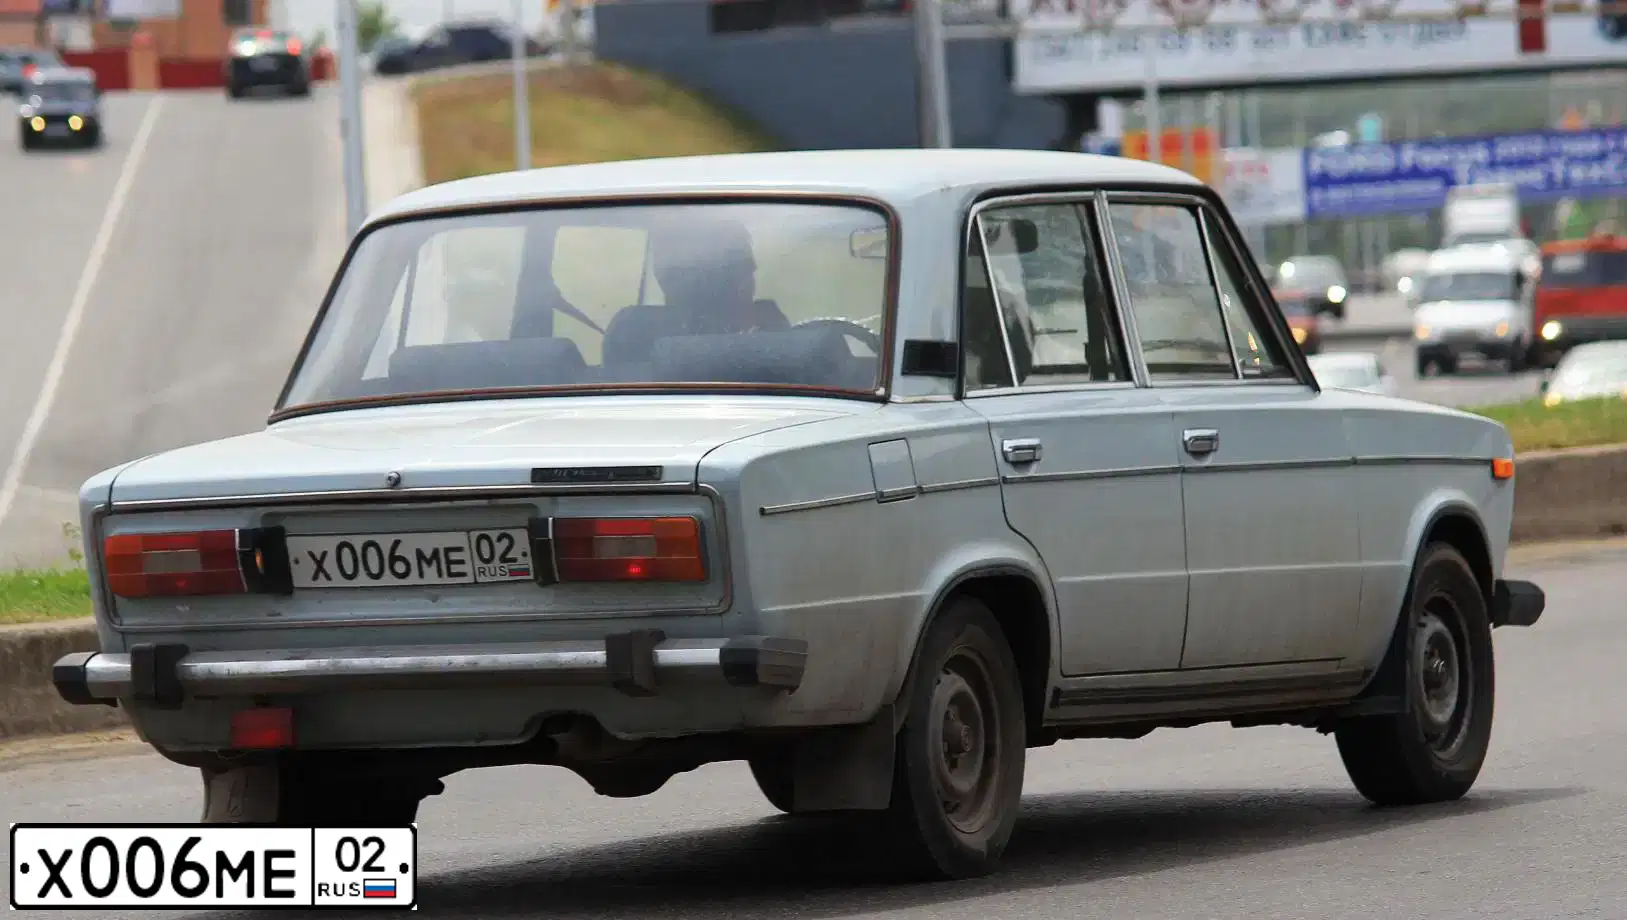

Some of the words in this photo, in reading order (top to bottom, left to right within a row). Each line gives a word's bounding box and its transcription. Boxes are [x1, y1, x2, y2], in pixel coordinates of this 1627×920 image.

[307, 539, 468, 582] Х006МЕ
[475, 532, 518, 565] 02
[478, 565, 508, 578] RUS
